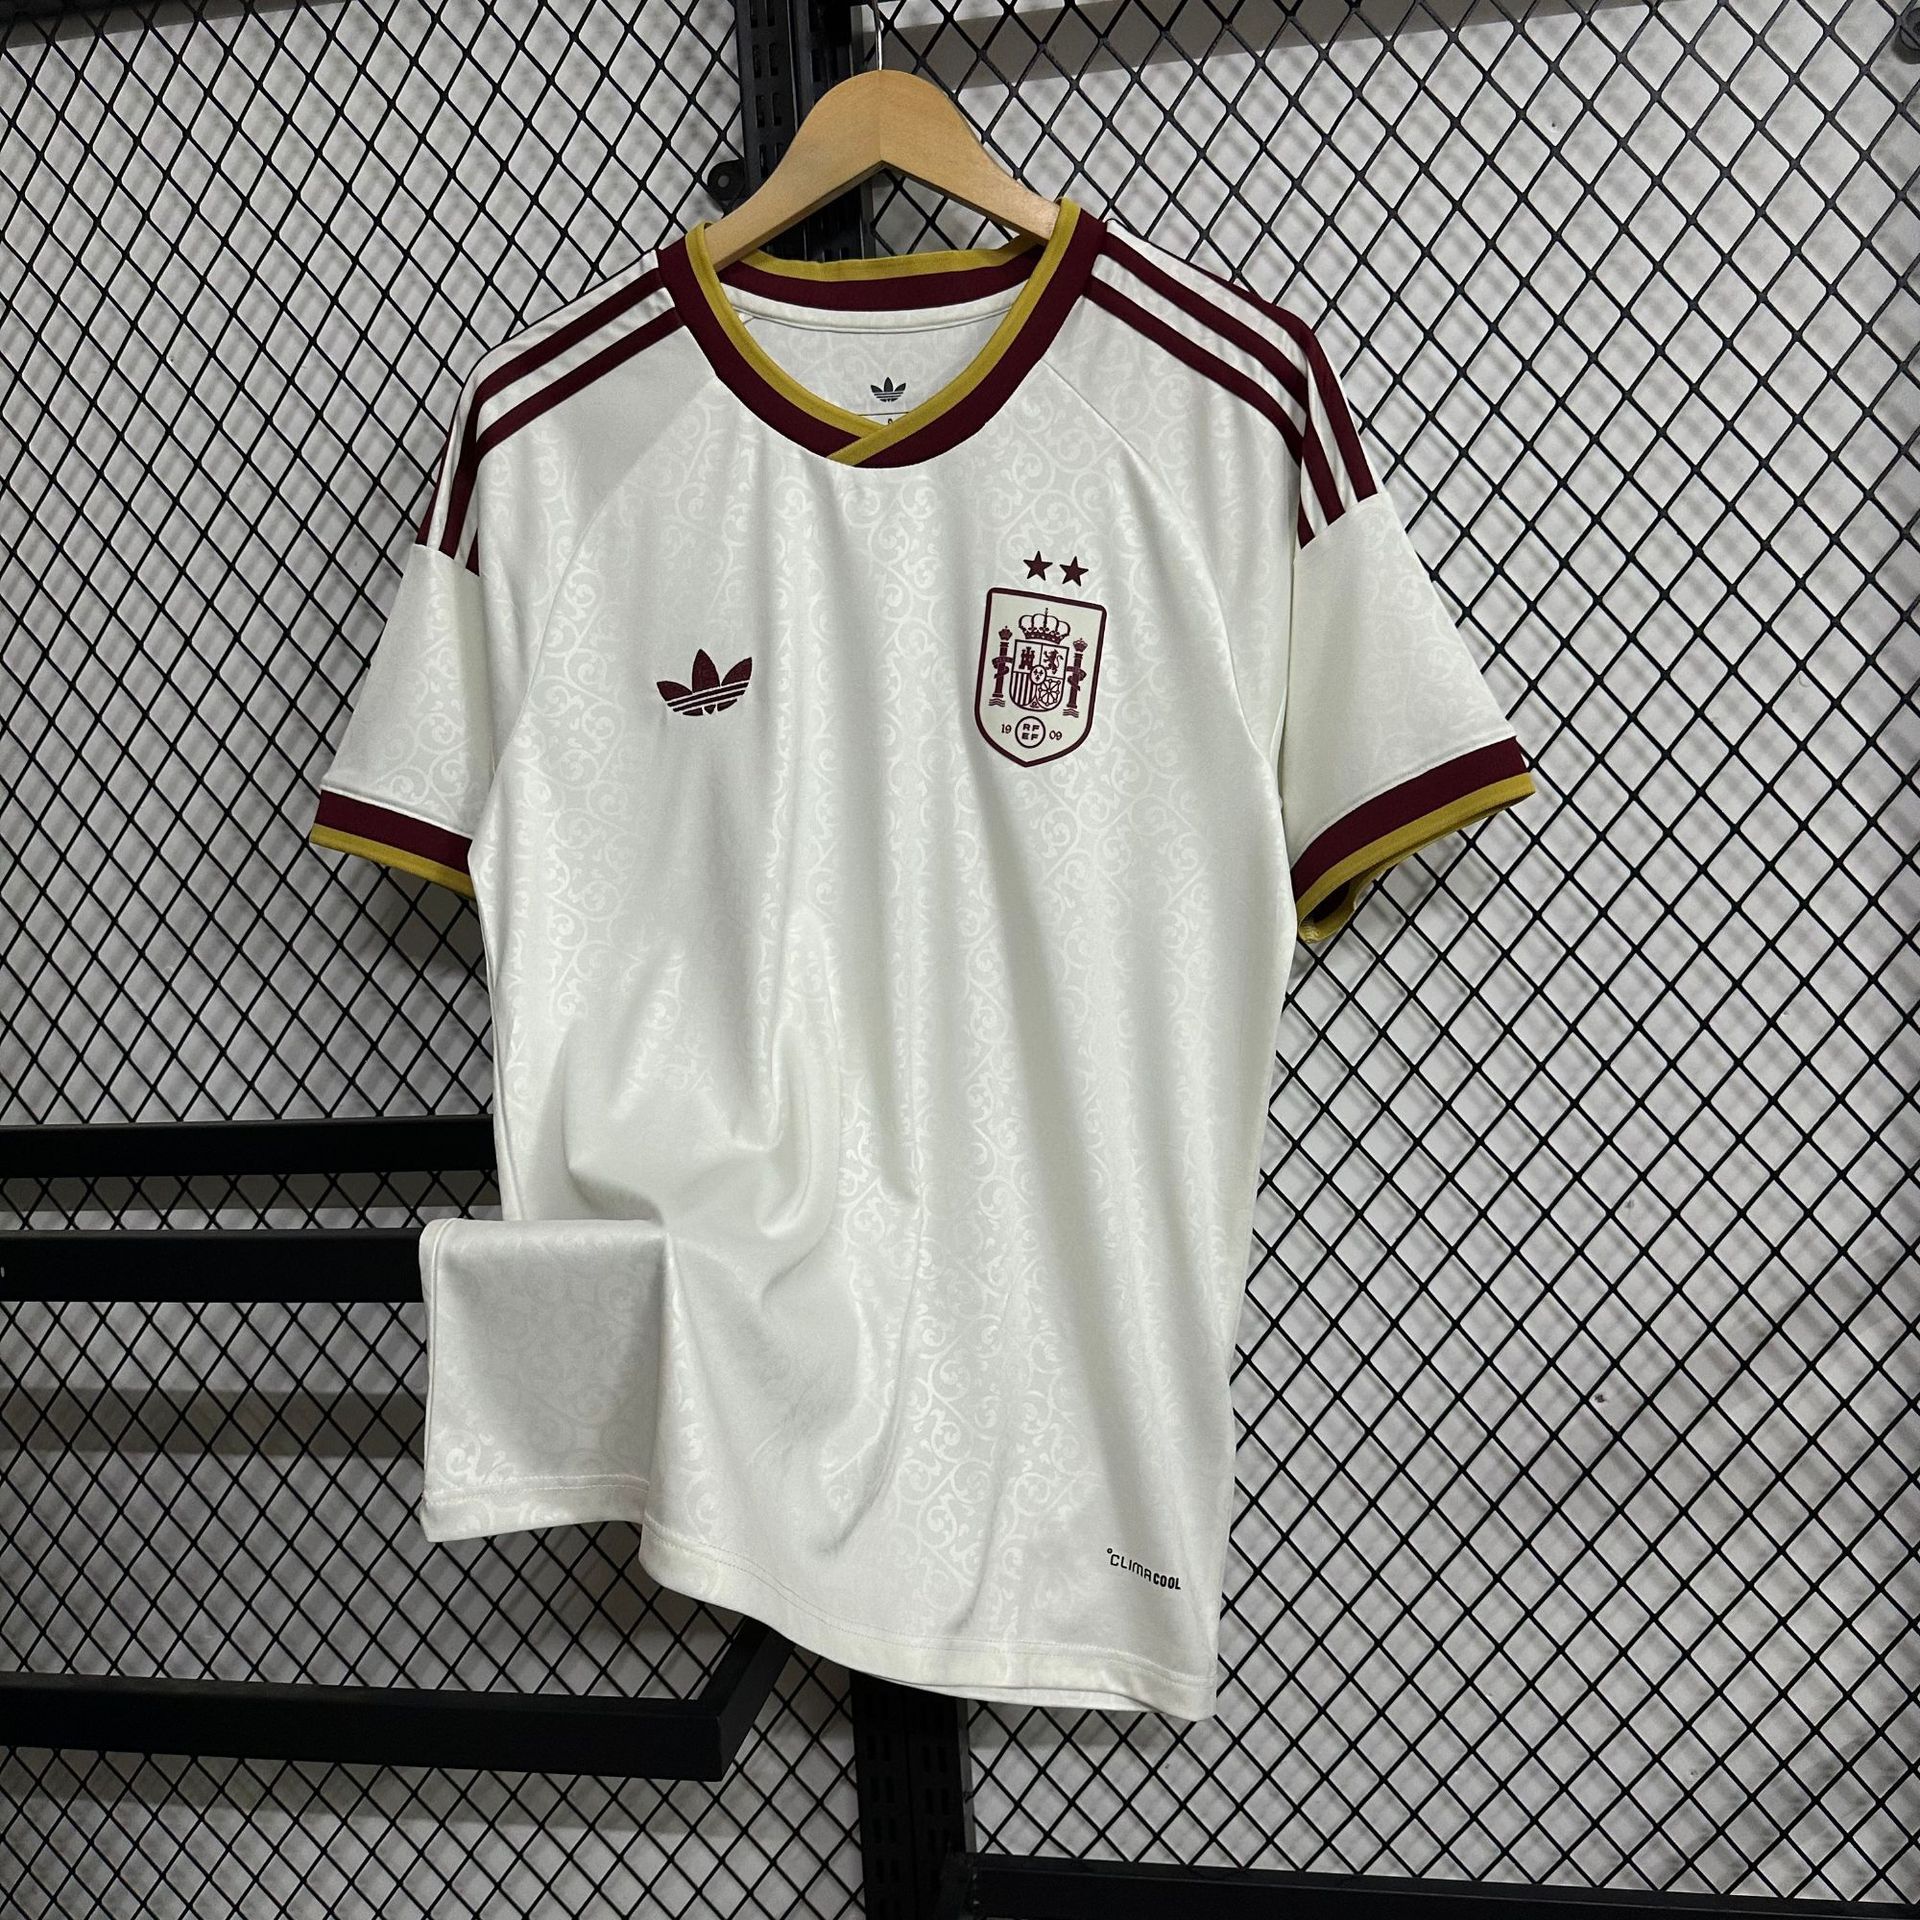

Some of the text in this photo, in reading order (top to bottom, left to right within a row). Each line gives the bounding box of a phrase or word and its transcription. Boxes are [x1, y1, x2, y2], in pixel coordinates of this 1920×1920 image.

[1001, 724, 1012, 734] 19
[1023, 723, 1040, 732] RF
[1021, 732, 1039, 741] EF
[1049, 730, 1063, 741] 09
